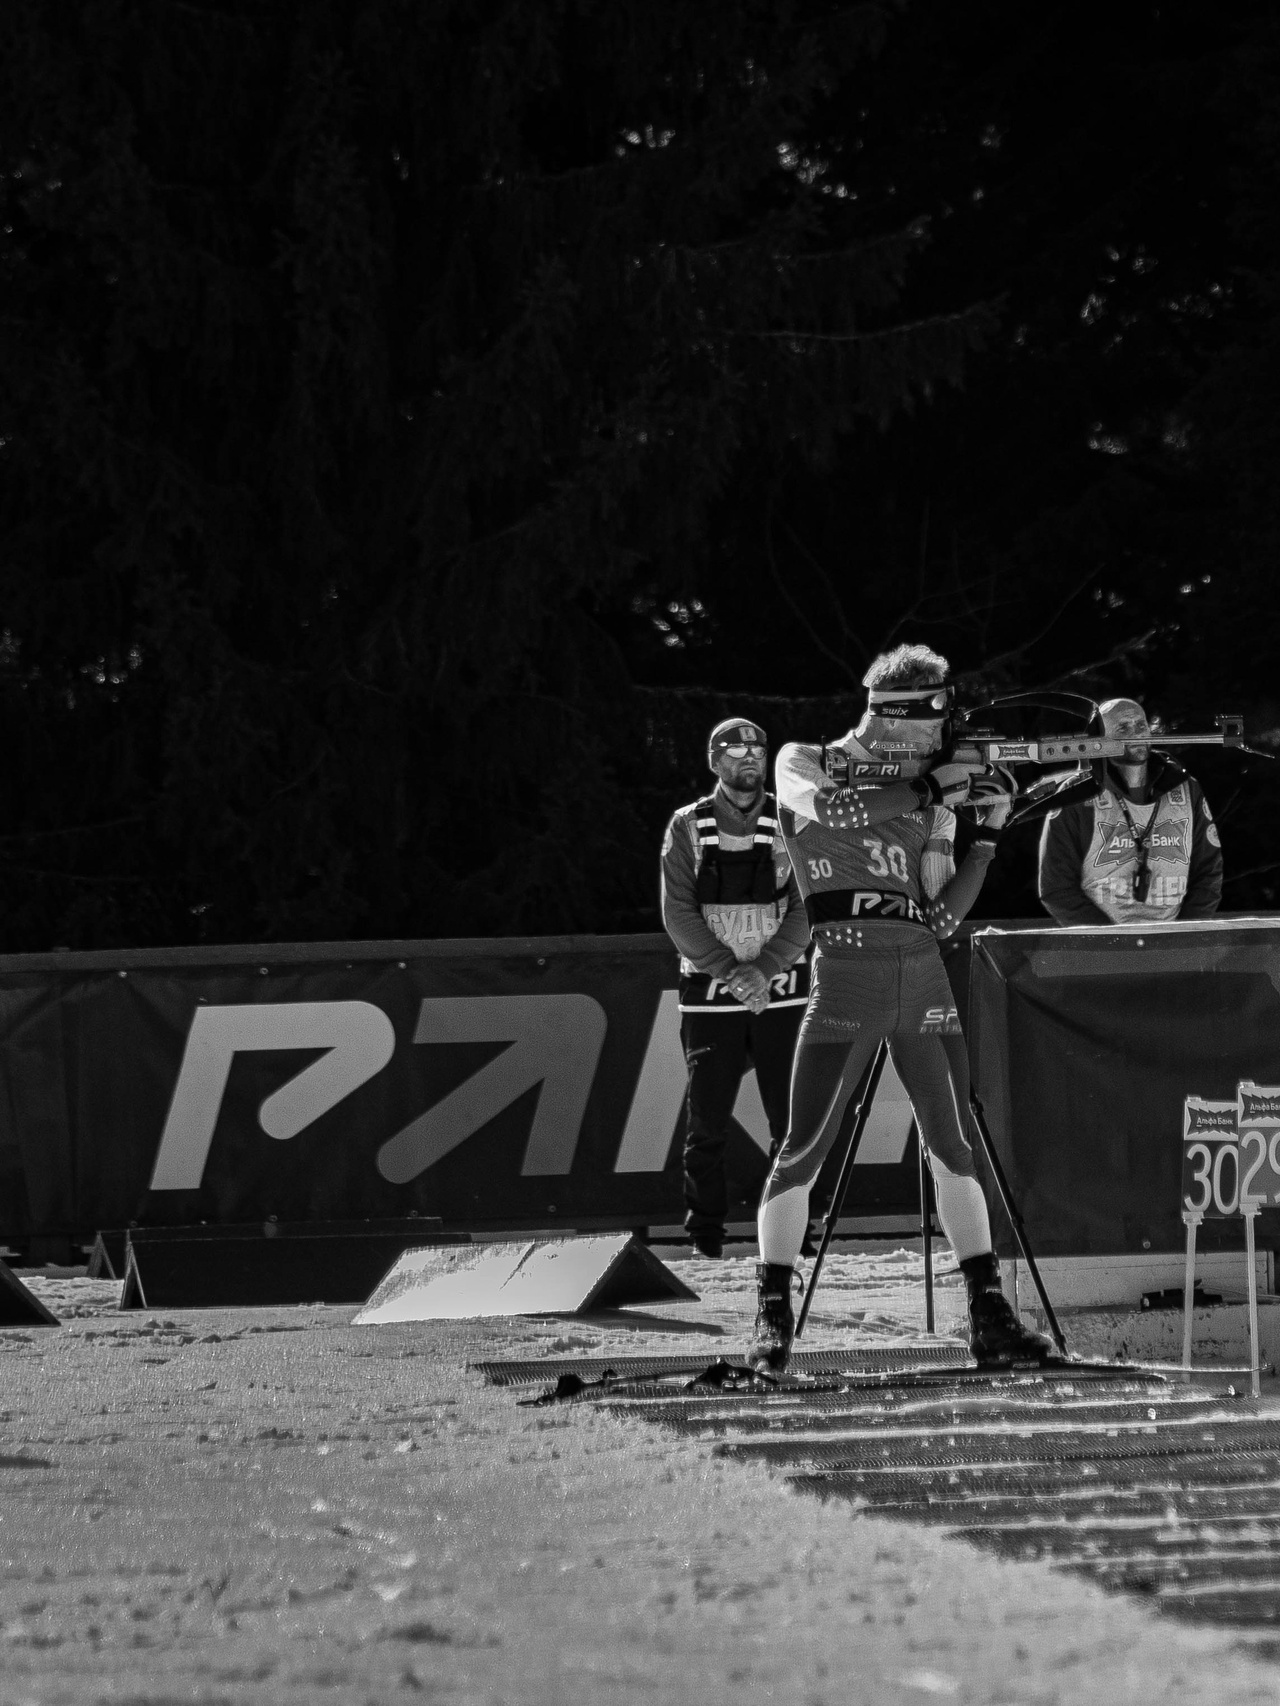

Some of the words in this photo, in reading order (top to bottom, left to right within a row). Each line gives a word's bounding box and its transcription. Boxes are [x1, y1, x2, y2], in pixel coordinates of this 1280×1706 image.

[882, 707, 909, 717] swix
[855, 764, 900, 776] PARI
[1151, 833, 1180, 847] Банк
[863, 839, 910, 883] 30
[808, 858, 833, 880] 30
[706, 970, 797, 1001] PRI
[1250, 1102, 1270, 1113] Альфа
[1196, 1117, 1217, 1127] Альфа
[1218, 1117, 1234, 1126] Банк
[1184, 1143, 1239, 1215] 30
